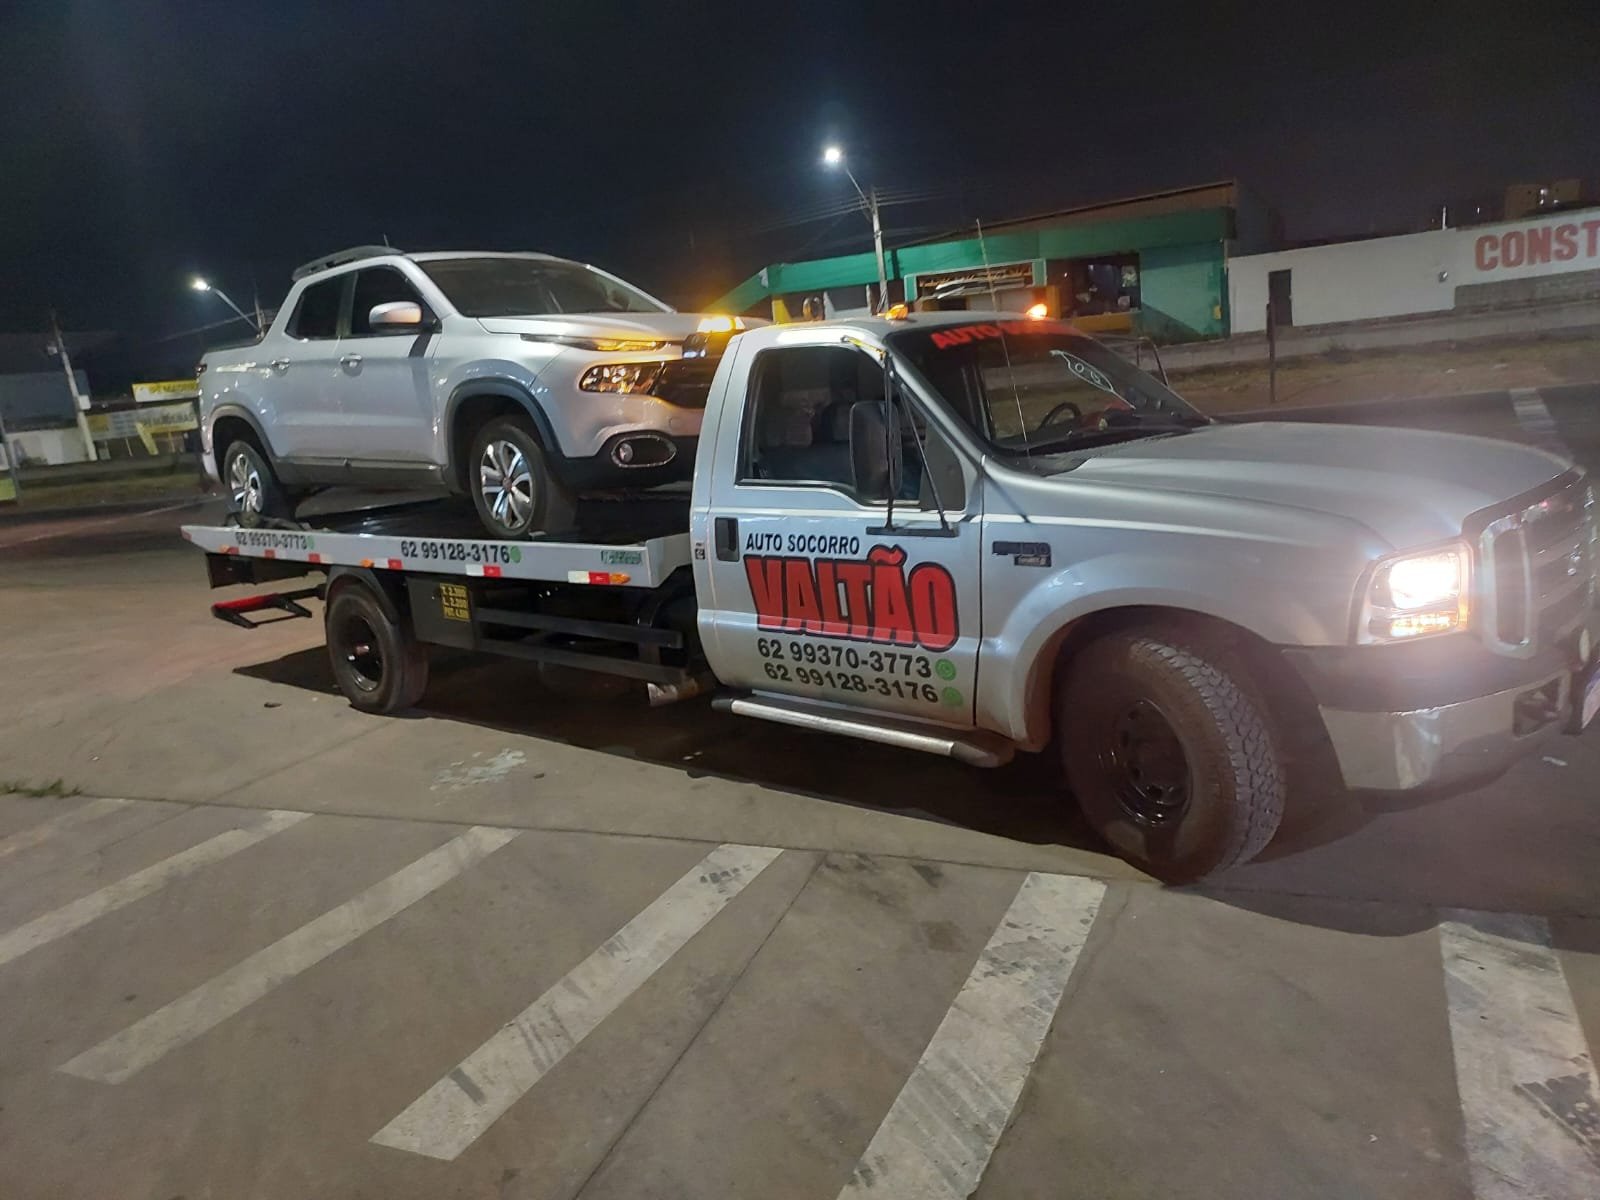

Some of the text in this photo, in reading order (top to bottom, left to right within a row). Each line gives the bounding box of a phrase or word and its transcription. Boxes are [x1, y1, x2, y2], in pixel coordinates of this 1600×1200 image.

[1475, 220, 1600, 272] CONST
[931, 325, 1000, 348] AUTO
[401, 540, 510, 563] 62 99128-3176
[746, 533, 860, 555] AUTO SOCORRO
[743, 543, 959, 653] VALTÃO
[757, 638, 932, 678] 62 99370-3773
[764, 662, 938, 703] 62 99128-3176
